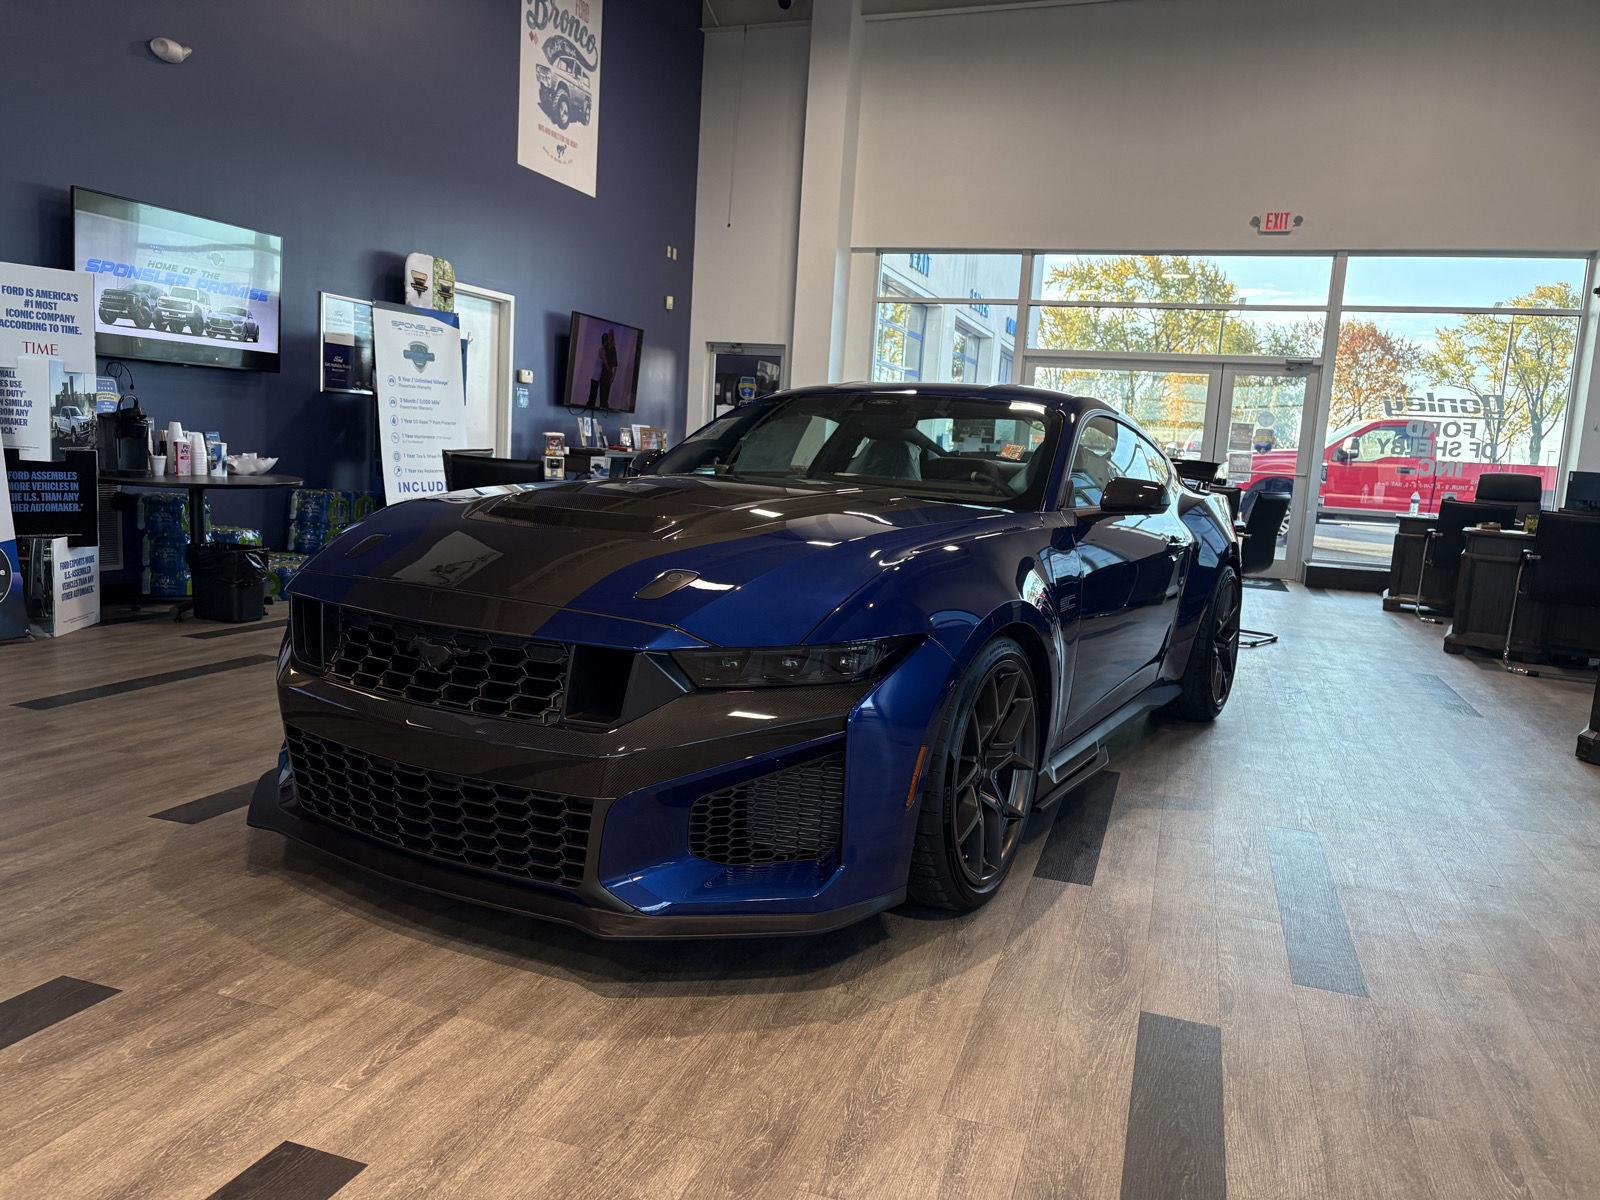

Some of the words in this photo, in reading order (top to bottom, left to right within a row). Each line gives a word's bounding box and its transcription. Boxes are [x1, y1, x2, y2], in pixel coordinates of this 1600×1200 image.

[1265, 212, 1290, 230] EXIT
[147, 259, 179, 273] HOME
[183, 266, 197, 276] OF
[201, 270, 221, 280] THE
[84, 258, 191, 287] SPONSLER
[195, 278, 271, 303] PROMISE
[1, 285, 24, 296] FORD
[26, 288, 34, 297] IS
[36, 289, 78, 302] AMERICA'S
[24, 299, 34, 308] #1
[35, 300, 58, 310] MOST
[6, 308, 34, 320] ICONIC
[36, 312, 76, 324] COMPANY
[0, 319, 47, 332] ACCORDING
[49, 323, 59, 332] TO
[61, 324, 82, 335] TIME.
[22, 341, 59, 356] TIME
[10, 380, 22, 388] USE
[4, 400, 32, 408] SIMILAR
[15, 408, 28, 417] ANY
[8, 471, 30, 480] FORD
[31, 471, 78, 480] ASSEMBLES
[32, 482, 70, 491] VEHICLES
[70, 482, 79, 490] IN
[398, 481, 447, 492] INCLUD
[24, 493, 40, 501] U.S.
[40, 493, 62, 502] THAN
[63, 493, 80, 501] ANY
[60, 562, 70, 571] FORD
[70, 558, 84, 568] EXPORTS
[85, 555, 94, 565] MORE
[62, 580, 78, 591] VEHICLES
